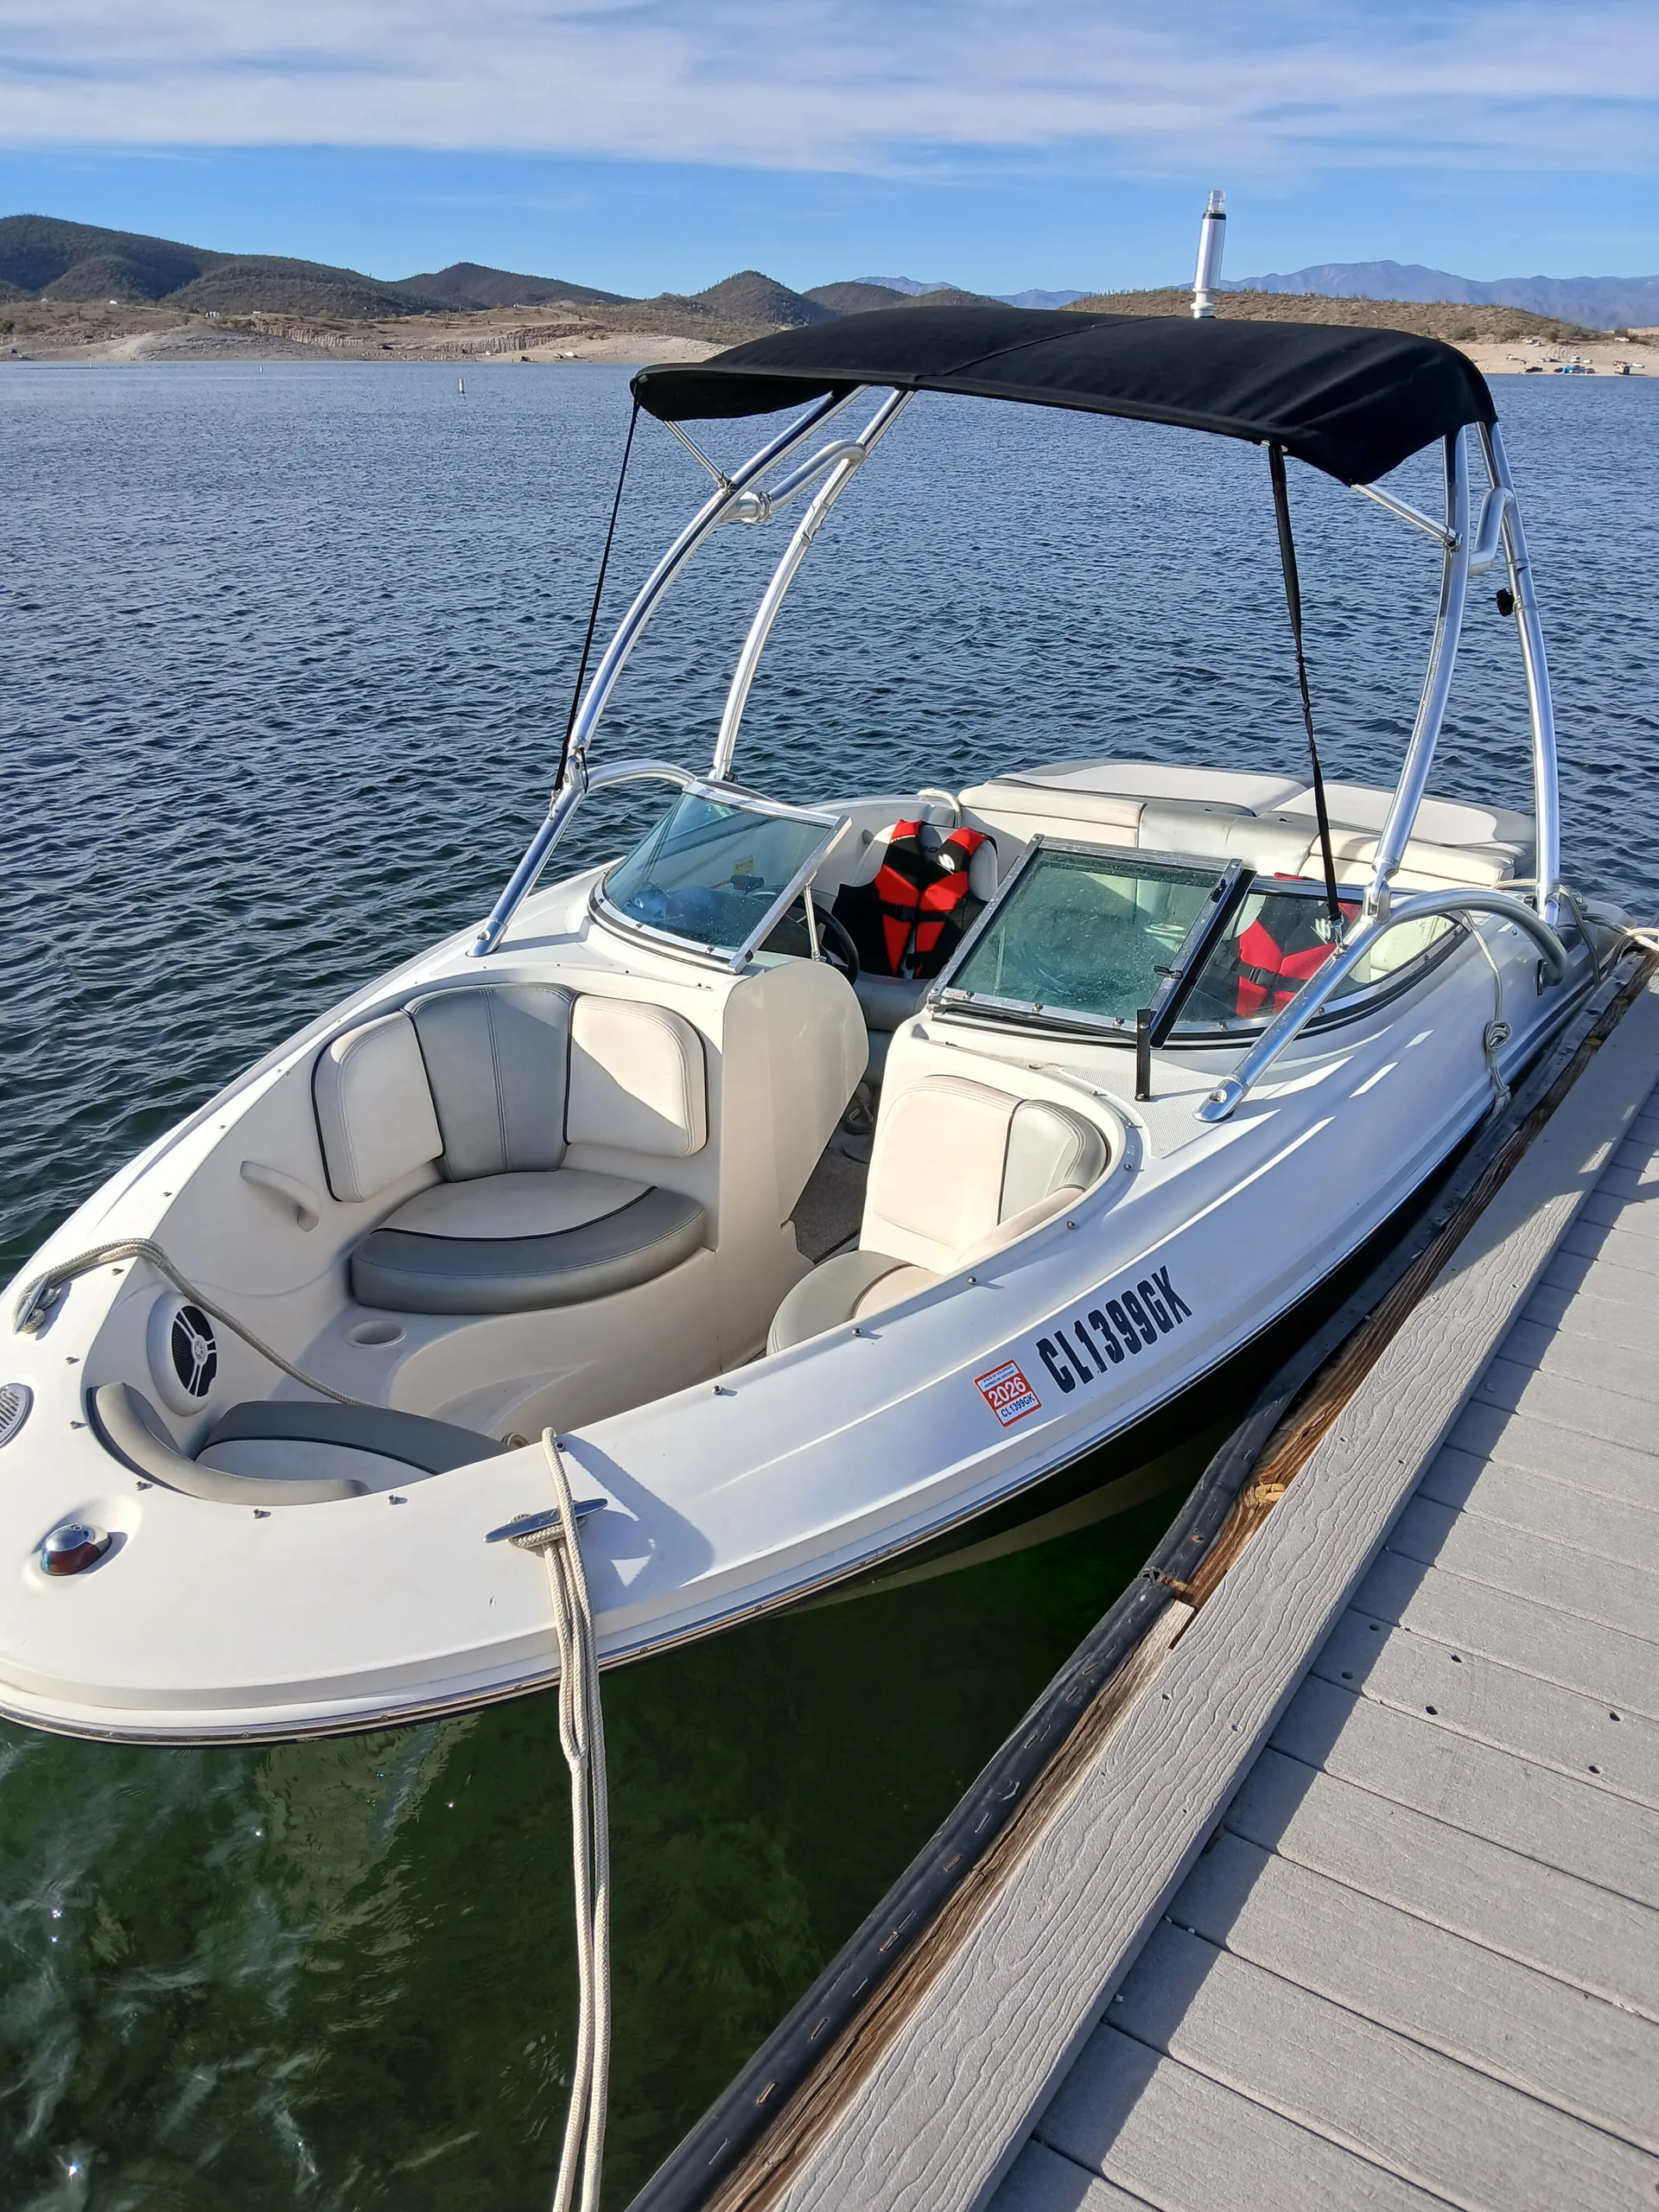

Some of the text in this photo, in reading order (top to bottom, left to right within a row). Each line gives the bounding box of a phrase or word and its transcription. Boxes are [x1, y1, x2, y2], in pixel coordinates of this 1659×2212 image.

[1036, 1265, 1192, 1393] CL1399GK
[988, 1376, 1027, 1408] 2026
[1001, 1393, 1035, 1417] CL1399GK
